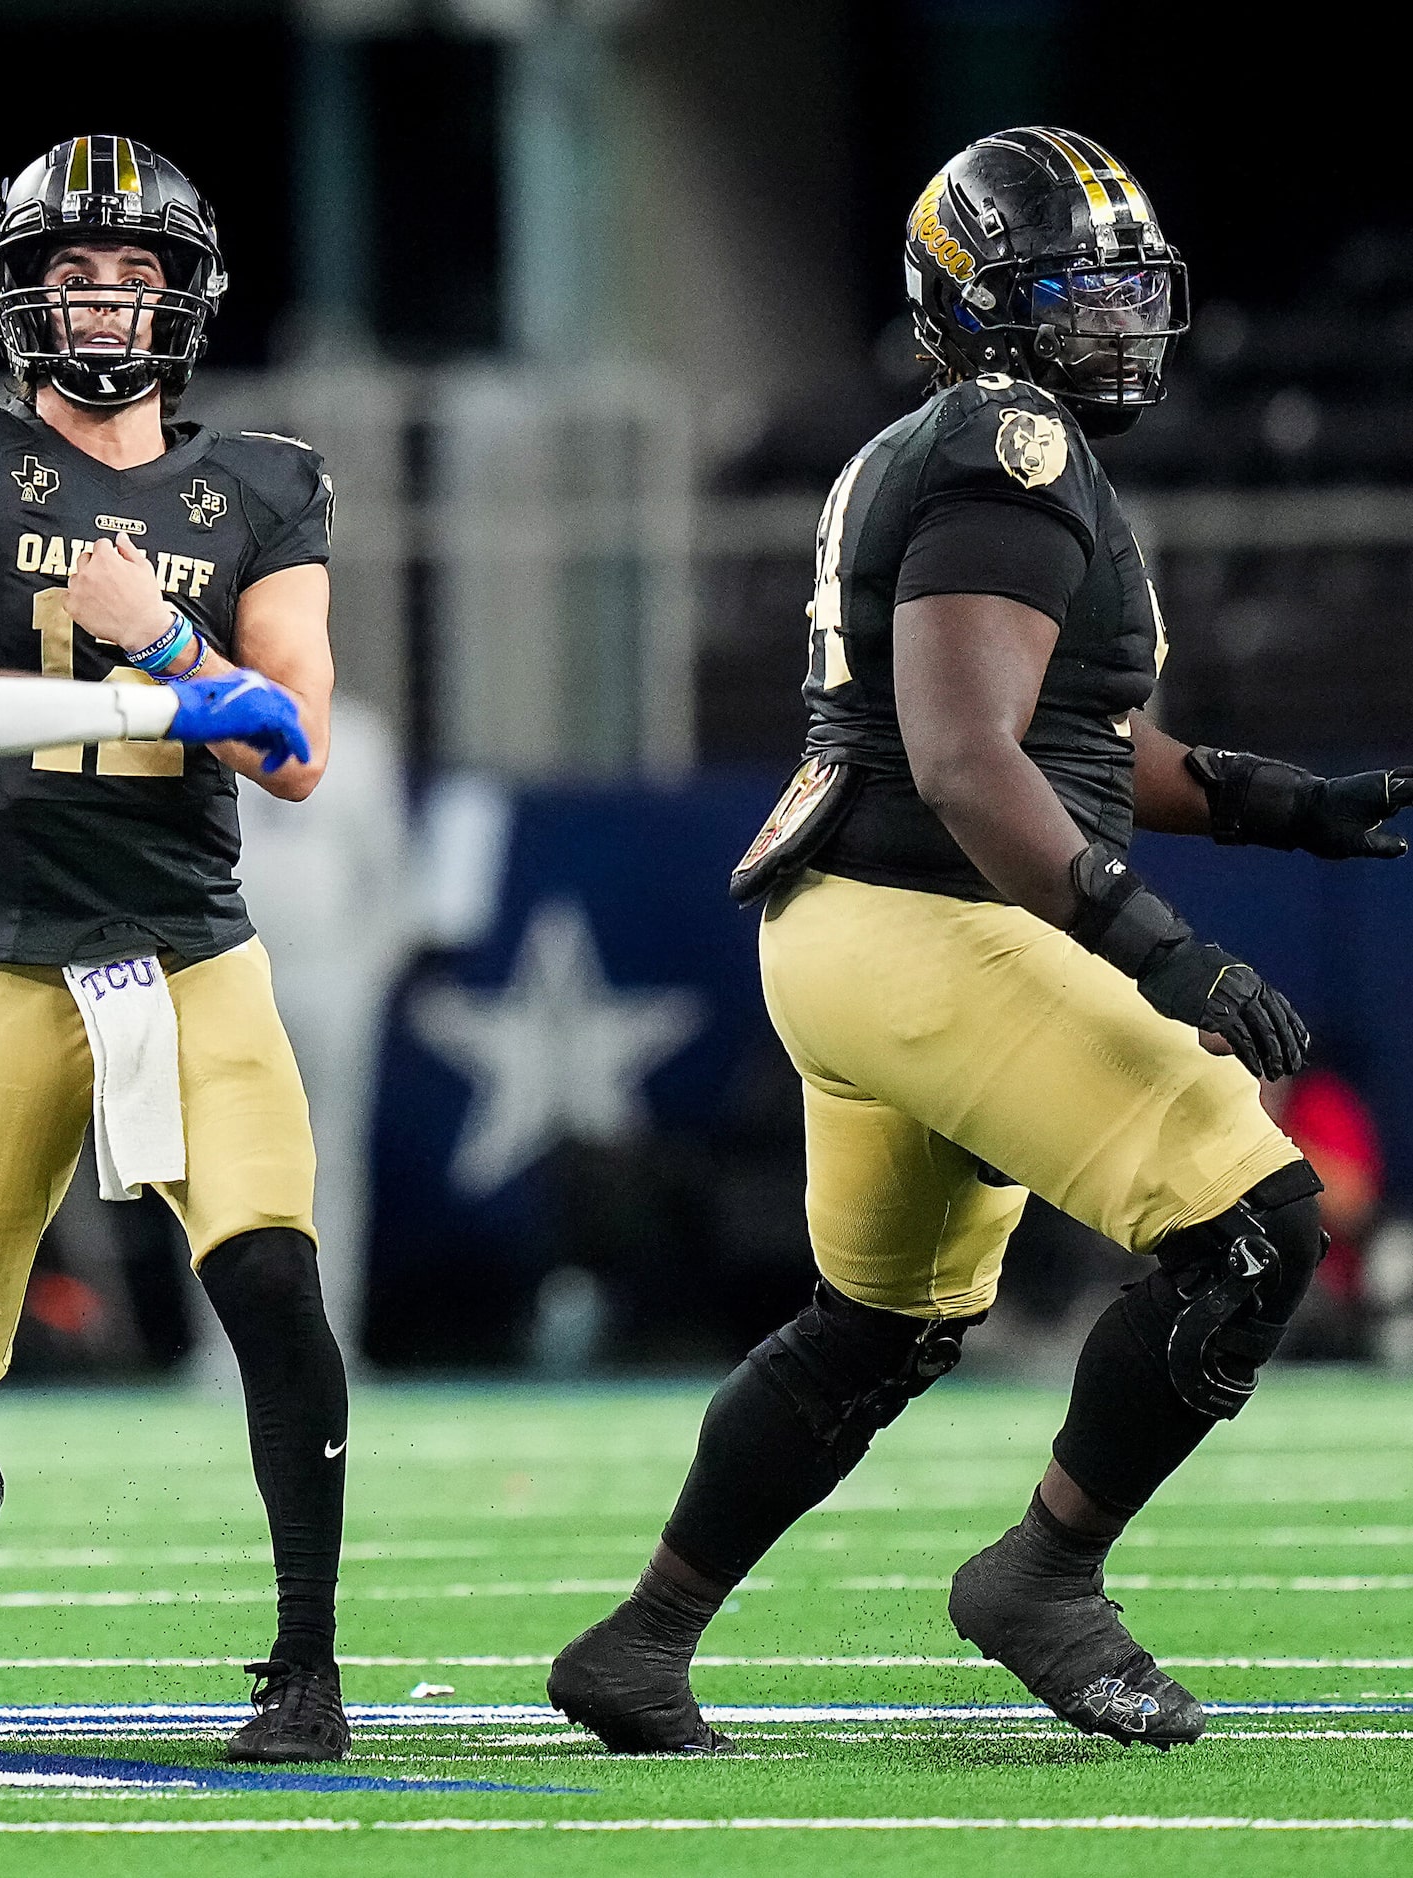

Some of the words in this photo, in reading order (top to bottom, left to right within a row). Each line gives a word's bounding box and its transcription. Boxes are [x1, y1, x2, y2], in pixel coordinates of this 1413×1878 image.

[32, 469, 48, 487] 21
[201, 493, 221, 513] 22
[156, 627, 177, 649] CAMP
[81, 957, 157, 1001] TCU
